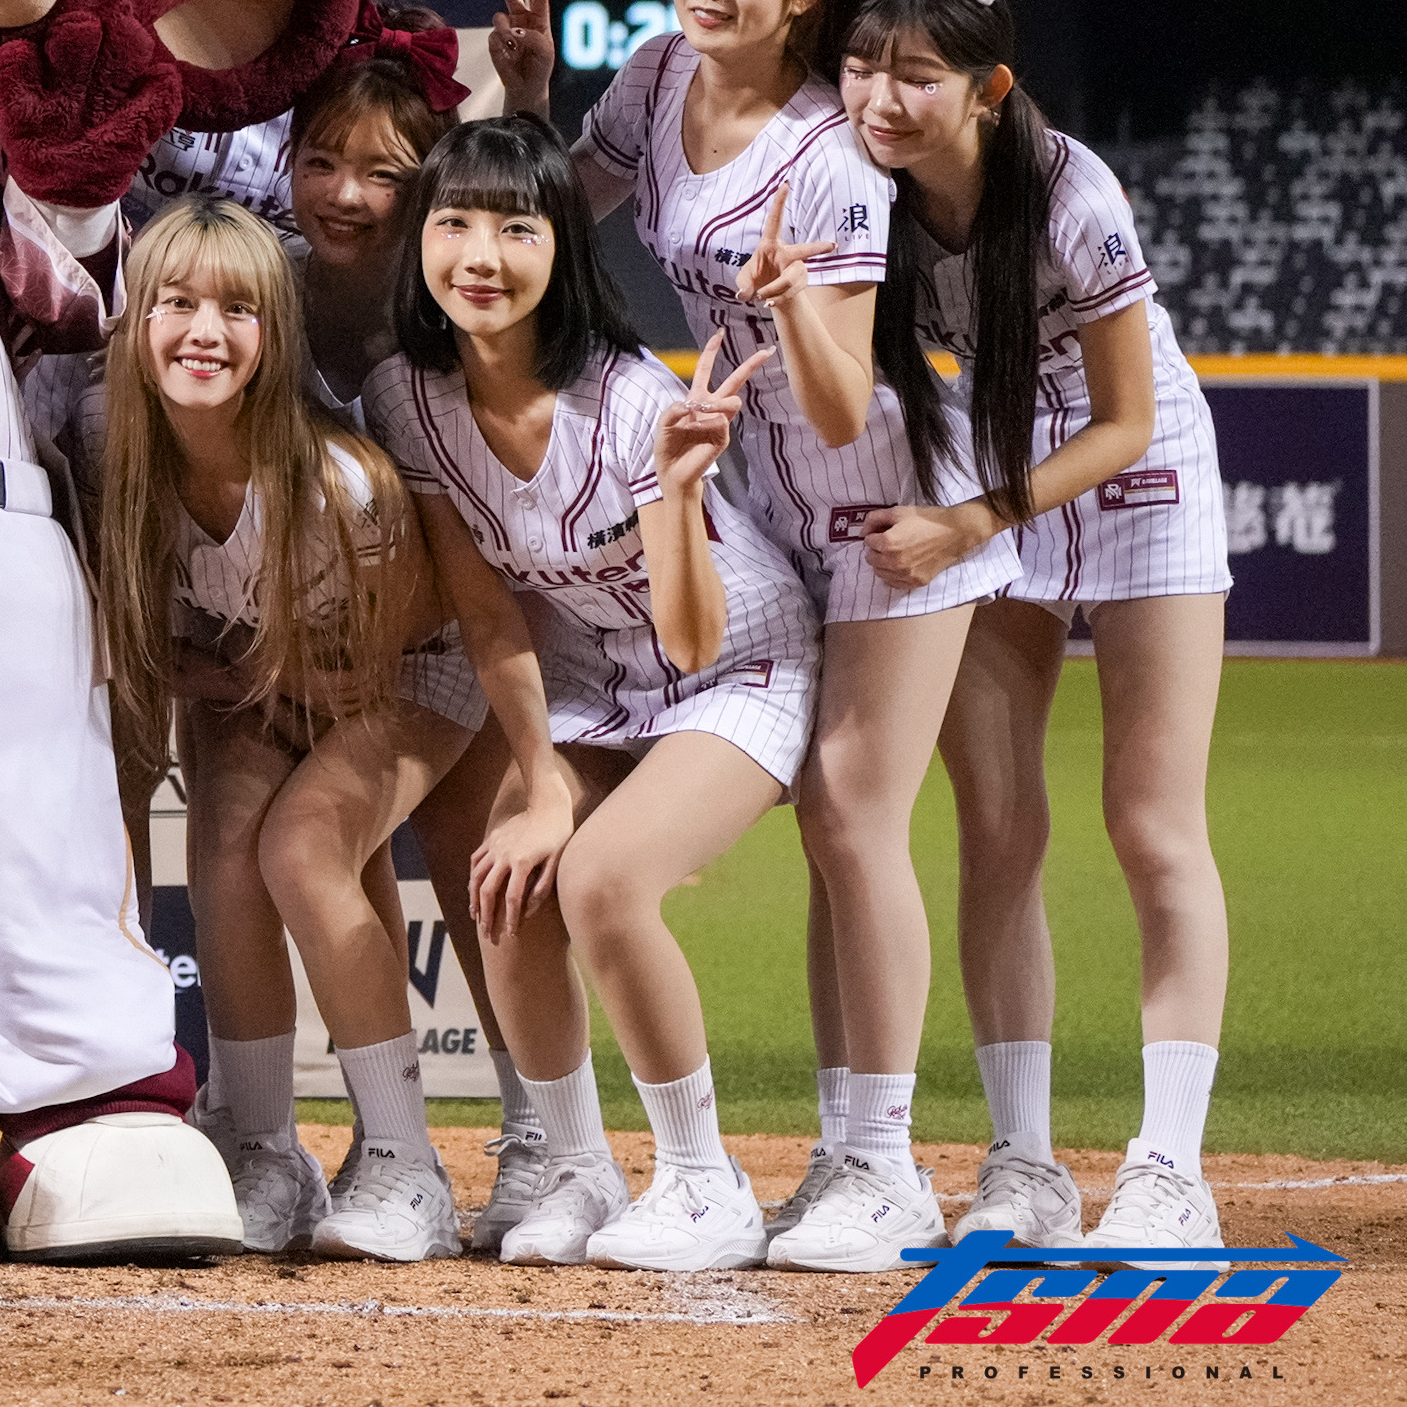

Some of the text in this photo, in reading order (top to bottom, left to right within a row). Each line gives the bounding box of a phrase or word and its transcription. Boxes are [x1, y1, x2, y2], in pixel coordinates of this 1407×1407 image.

[837, 202, 869, 233] 浪
[240, 1141, 262, 1151] FILA
[368, 1148, 395, 1158] FILA
[988, 1139, 1010, 1156] FILA
[844, 1155, 869, 1170] FILA
[1147, 1151, 1174, 1169] FILA
[410, 1193, 423, 1211] FILA
[871, 1205, 890, 1223] FILA
[1178, 1208, 1191, 1226] FILA
